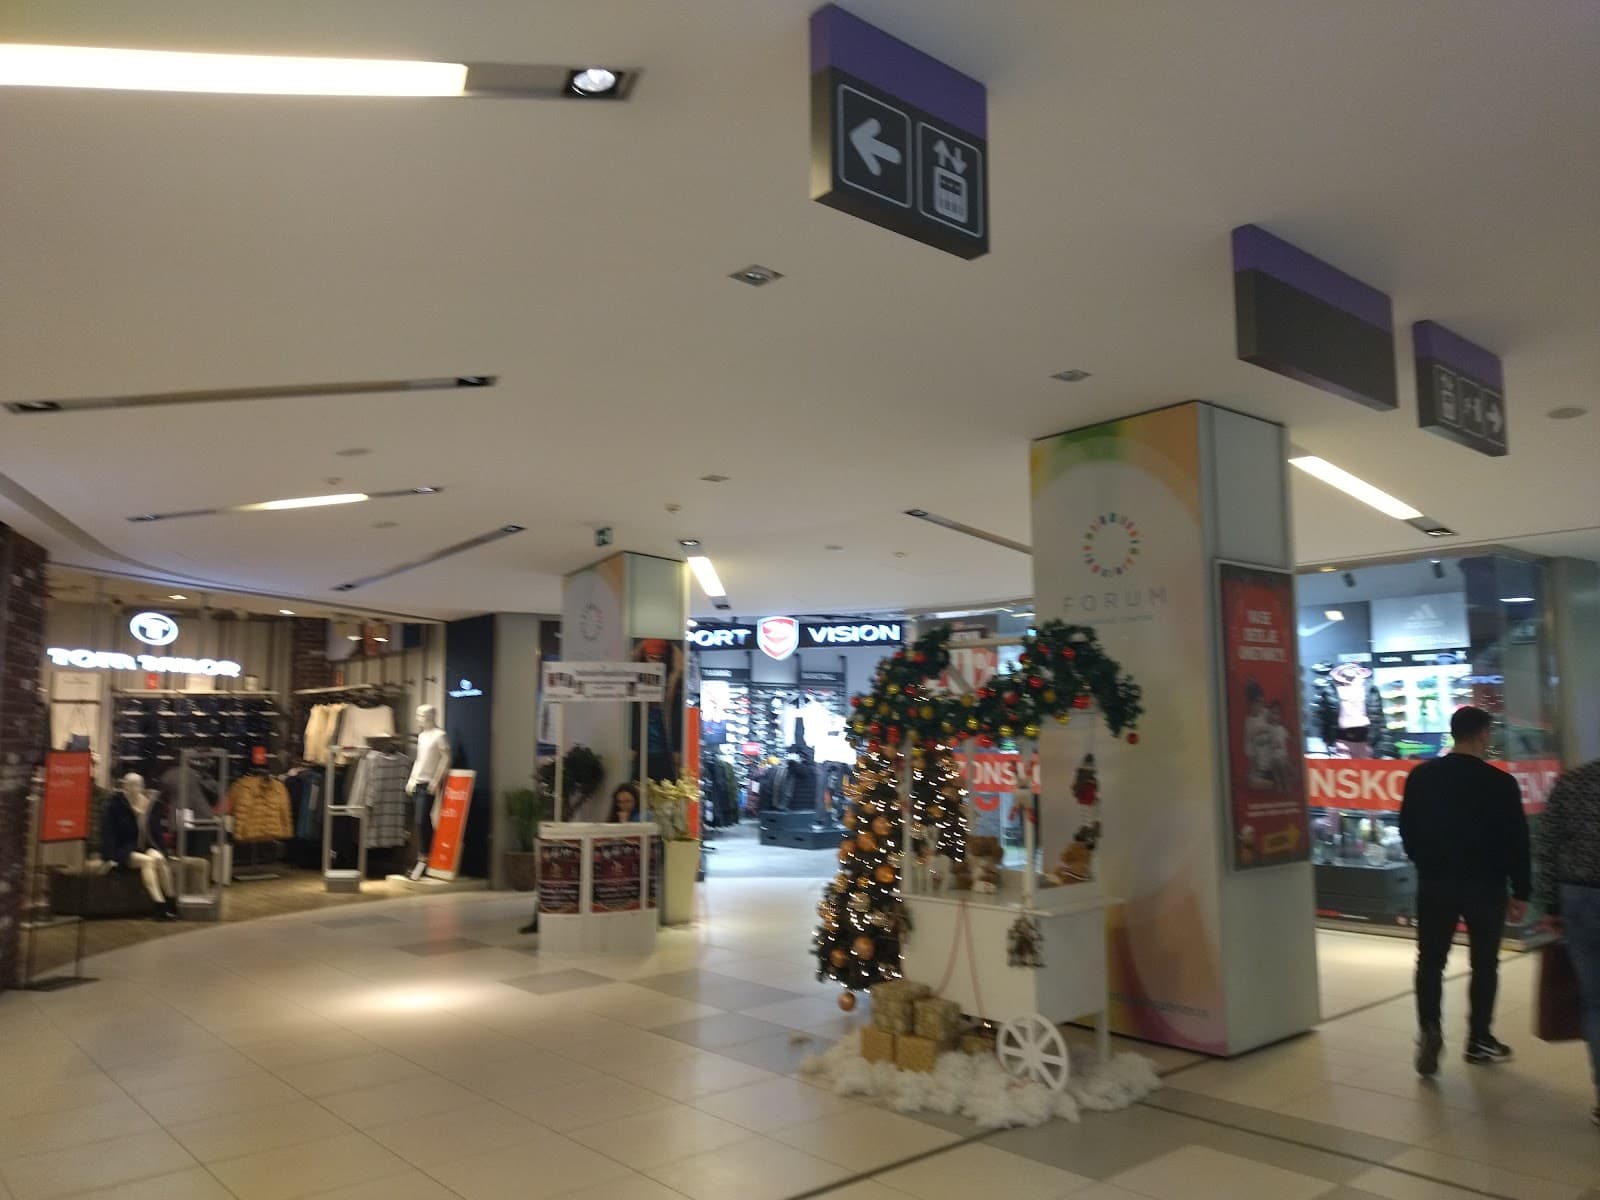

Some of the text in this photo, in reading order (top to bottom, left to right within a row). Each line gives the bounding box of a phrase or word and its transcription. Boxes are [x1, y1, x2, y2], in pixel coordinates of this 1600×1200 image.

[1063, 586, 1168, 612] FORUM
[685, 624, 901, 647] PORT VISION
